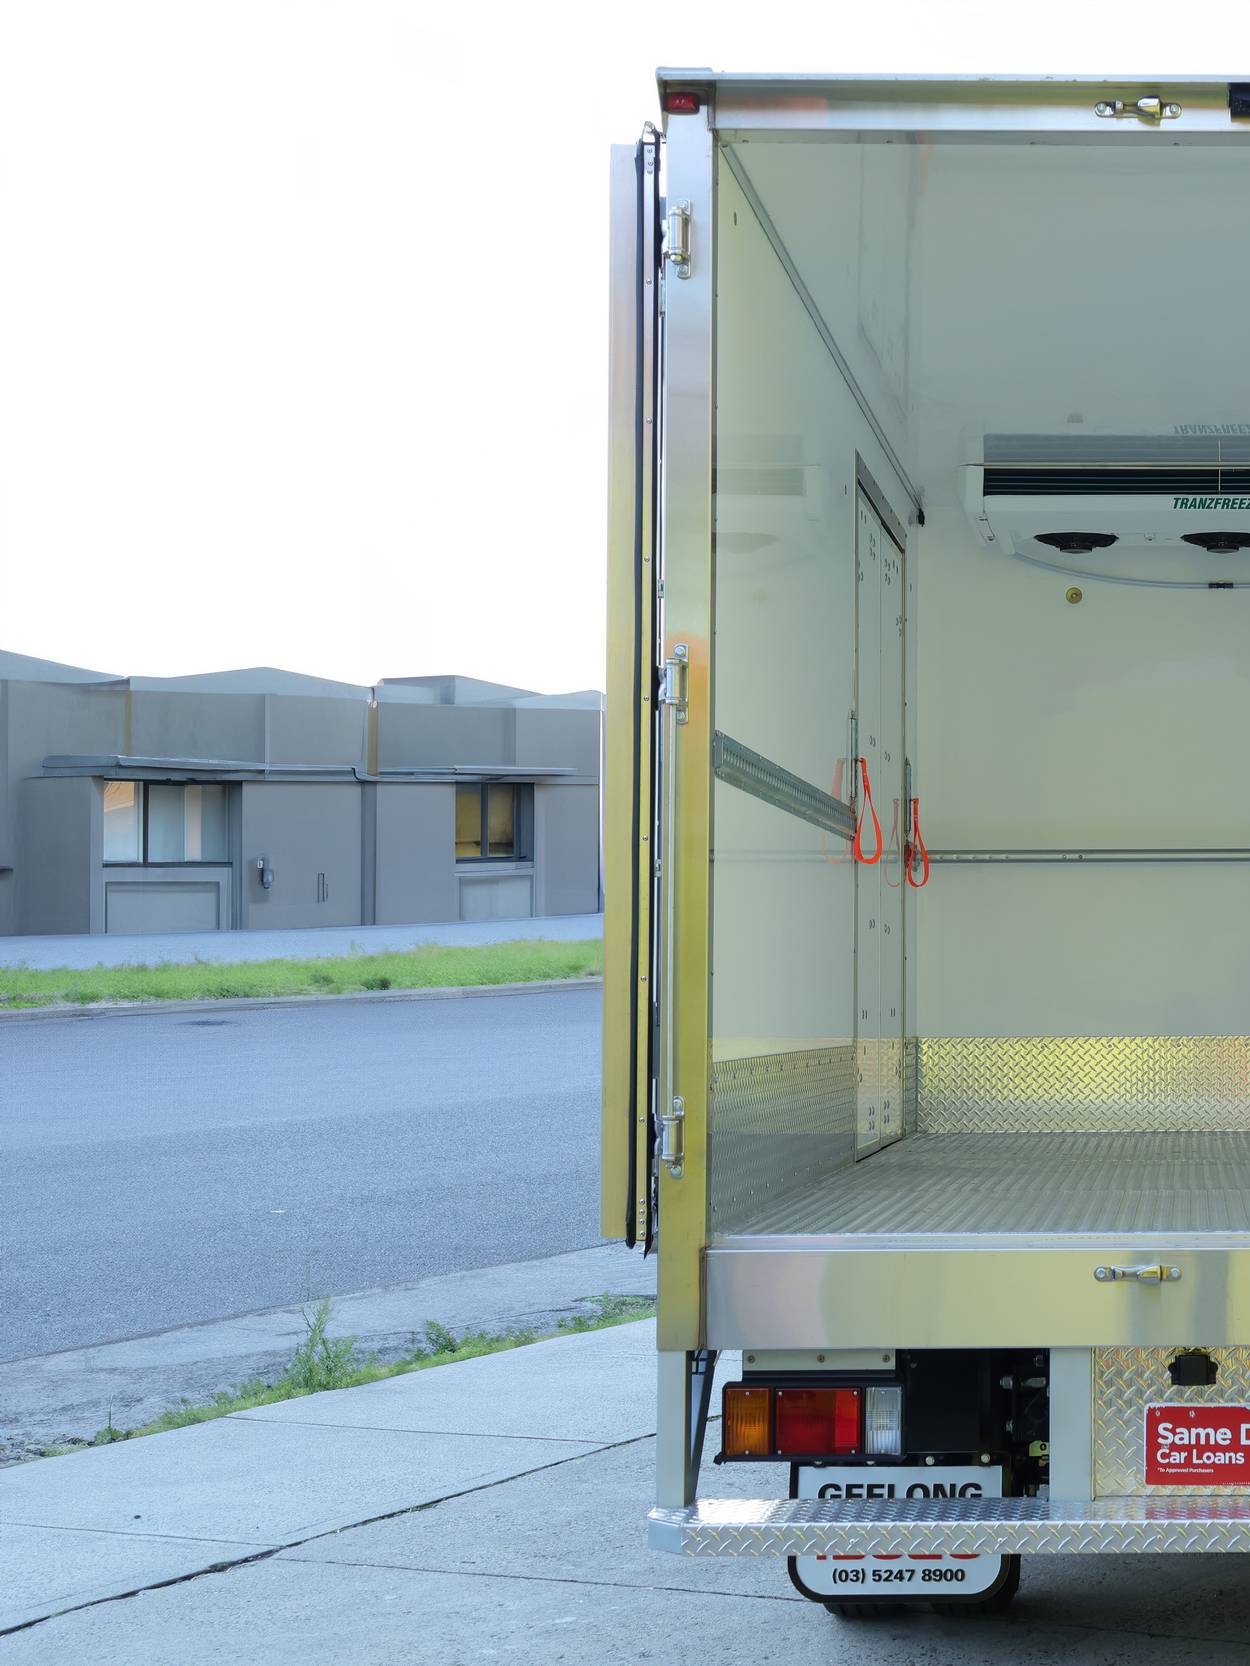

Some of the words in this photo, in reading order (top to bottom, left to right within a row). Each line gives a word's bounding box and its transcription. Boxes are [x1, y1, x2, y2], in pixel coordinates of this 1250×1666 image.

[1157, 1423, 1232, 1445] Same
[1156, 1449, 1187, 1464] Car
[1192, 1450, 1245, 1464] Loans
[832, 1568, 866, 1584] (03)
[872, 1569, 915, 1583] 5247
[921, 1568, 966, 1583] 8900
